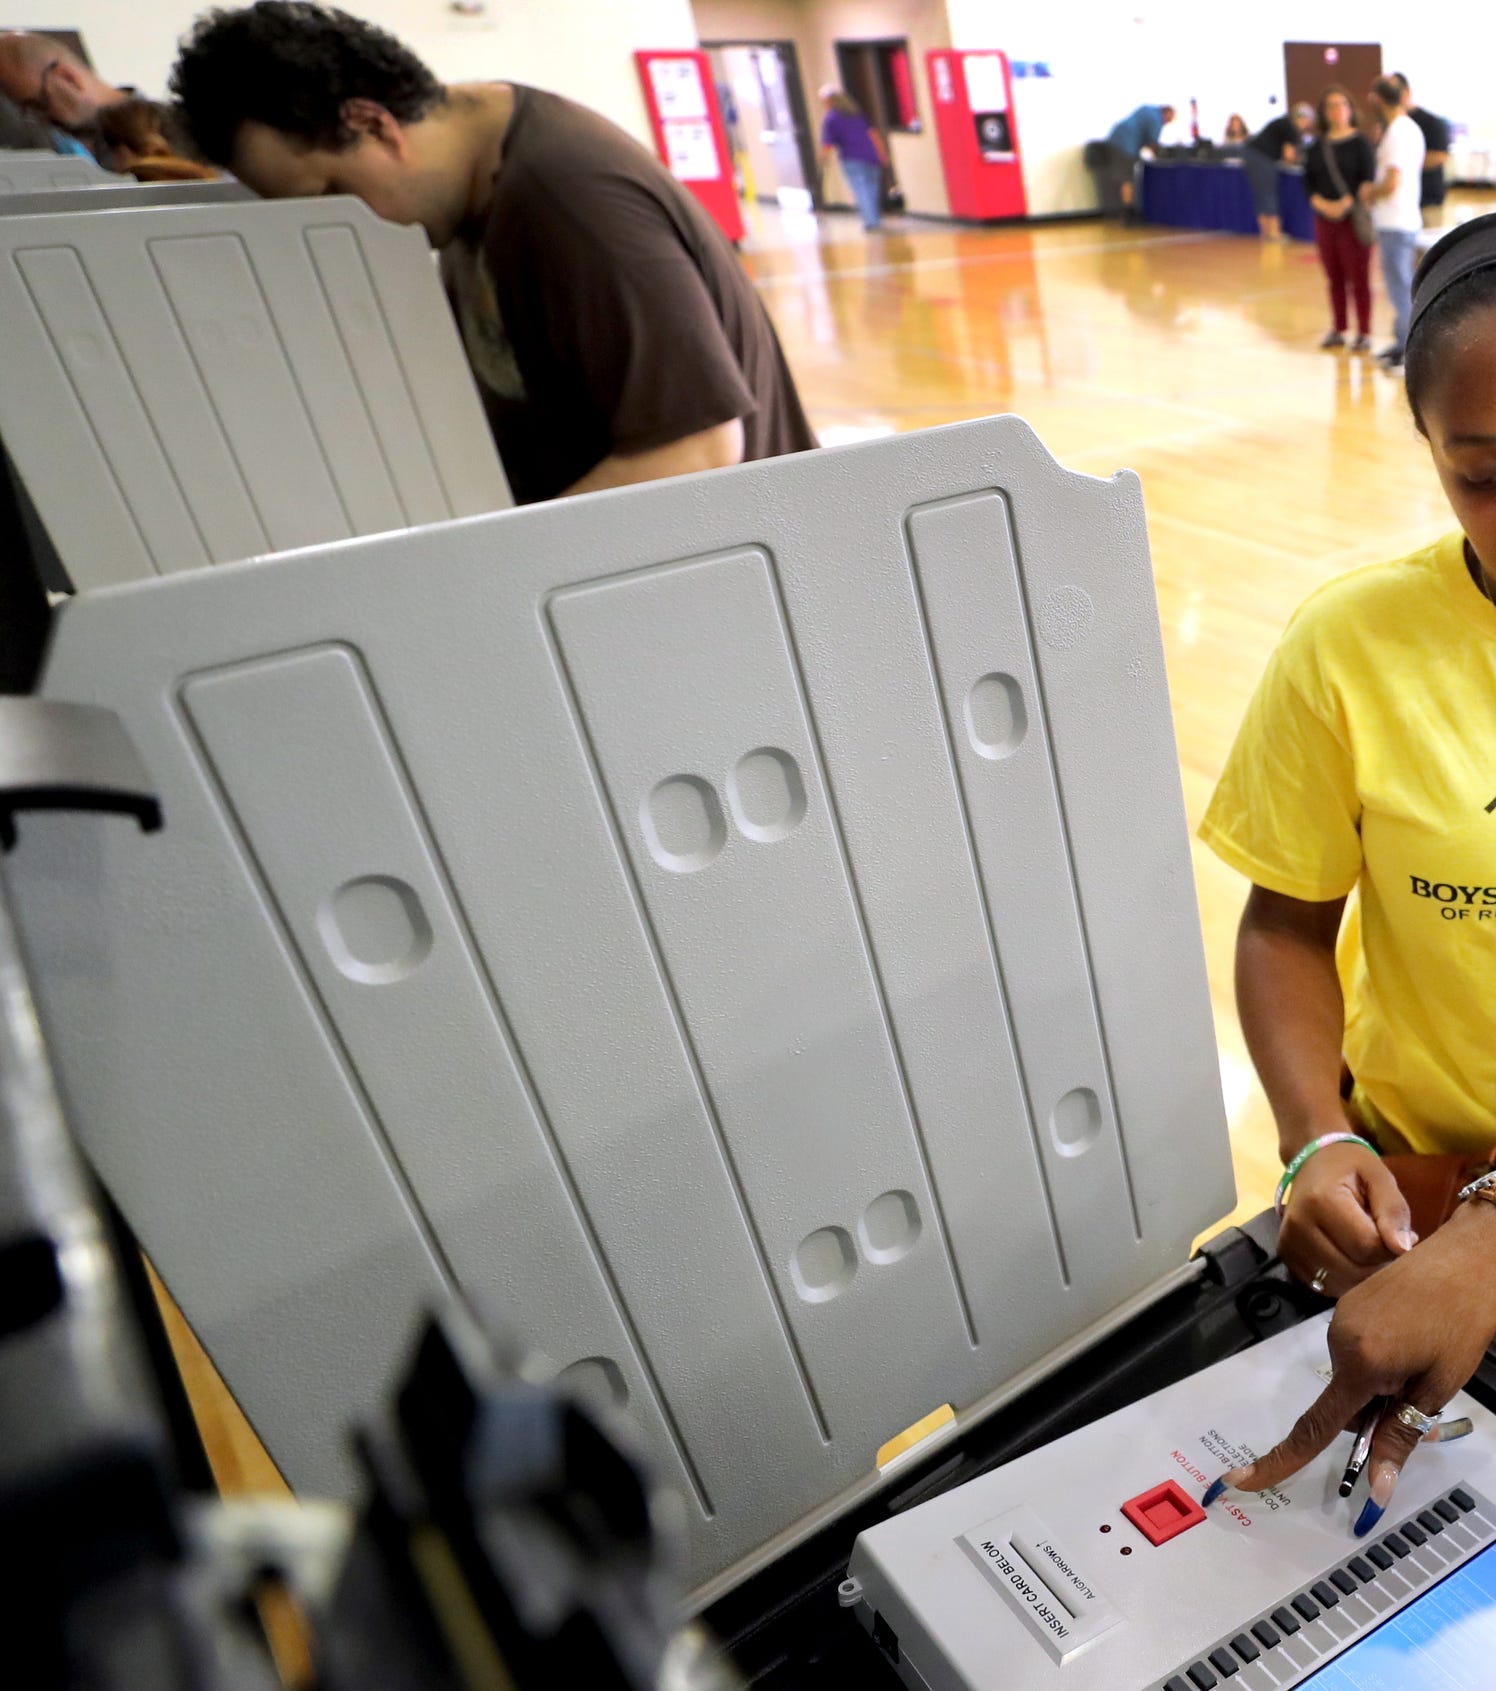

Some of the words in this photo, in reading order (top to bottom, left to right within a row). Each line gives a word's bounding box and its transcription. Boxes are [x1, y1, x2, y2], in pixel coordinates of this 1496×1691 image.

[1440, 907, 1471, 920] OF
[1199, 1435, 1231, 1464] BUTTON
[1207, 1429, 1250, 1468] ELECTIONS
[1170, 1449, 1207, 1484] BUTTON
[1264, 1498, 1280, 1511] DO
[1268, 1486, 1291, 1506] UNTI
[1225, 1501, 1252, 1528] CAST
[981, 1541, 1014, 1575] BELOW
[1043, 1545, 1075, 1577] ARROWS
[1011, 1574, 1038, 1603] CARD
[1071, 1576, 1096, 1600] ALIGN
[1033, 1603, 1069, 1639] INSERT
